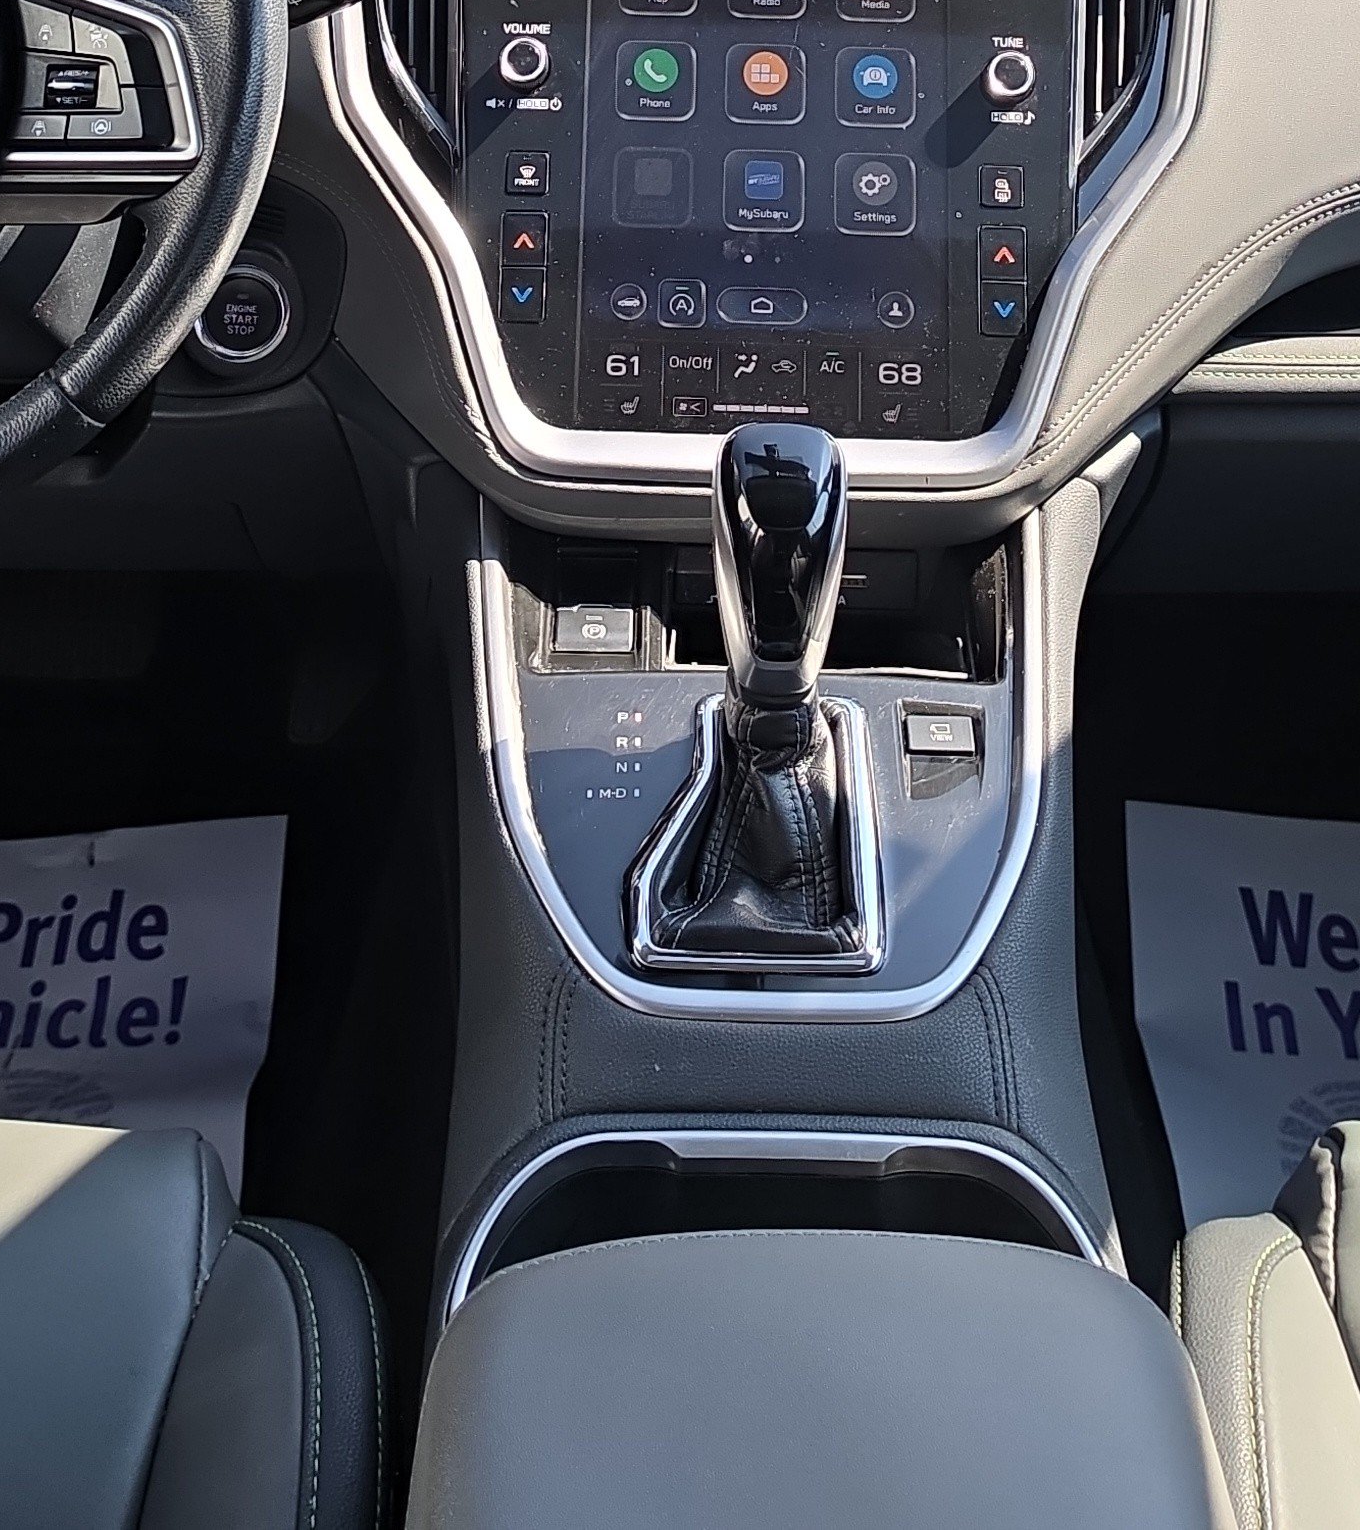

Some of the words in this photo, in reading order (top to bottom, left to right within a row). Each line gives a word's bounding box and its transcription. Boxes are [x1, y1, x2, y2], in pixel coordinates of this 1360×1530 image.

[861, 0, 891, 10] Media
[503, 23, 551, 34] VOLUME
[992, 37, 1024, 48] TUNE
[517, 99, 549, 109] HOLD
[640, 98, 671, 108] Phone
[752, 102, 778, 113] Apps
[855, 105, 874, 115] Car
[876, 105, 896, 115] Info
[991, 111, 1024, 123] HOLD
[514, 178, 540, 187] FRONT
[738, 208, 789, 220] MySubaru
[853, 211, 897, 224] Settings
[226, 303, 258, 314] ENGINE
[223, 314, 259, 325] START
[227, 325, 255, 335] STOP
[605, 354, 640, 377] 61
[669, 355, 713, 371] On/Off
[819, 358, 845, 373] A/C
[878, 363, 922, 386] 68
[617, 711, 629, 724] P
[615, 736, 629, 749] R
[930, 733, 953, 742] VIEW
[615, 761, 628, 773] N
[1239, 886, 1360, 972] We
[1224, 979, 1300, 1057] In
